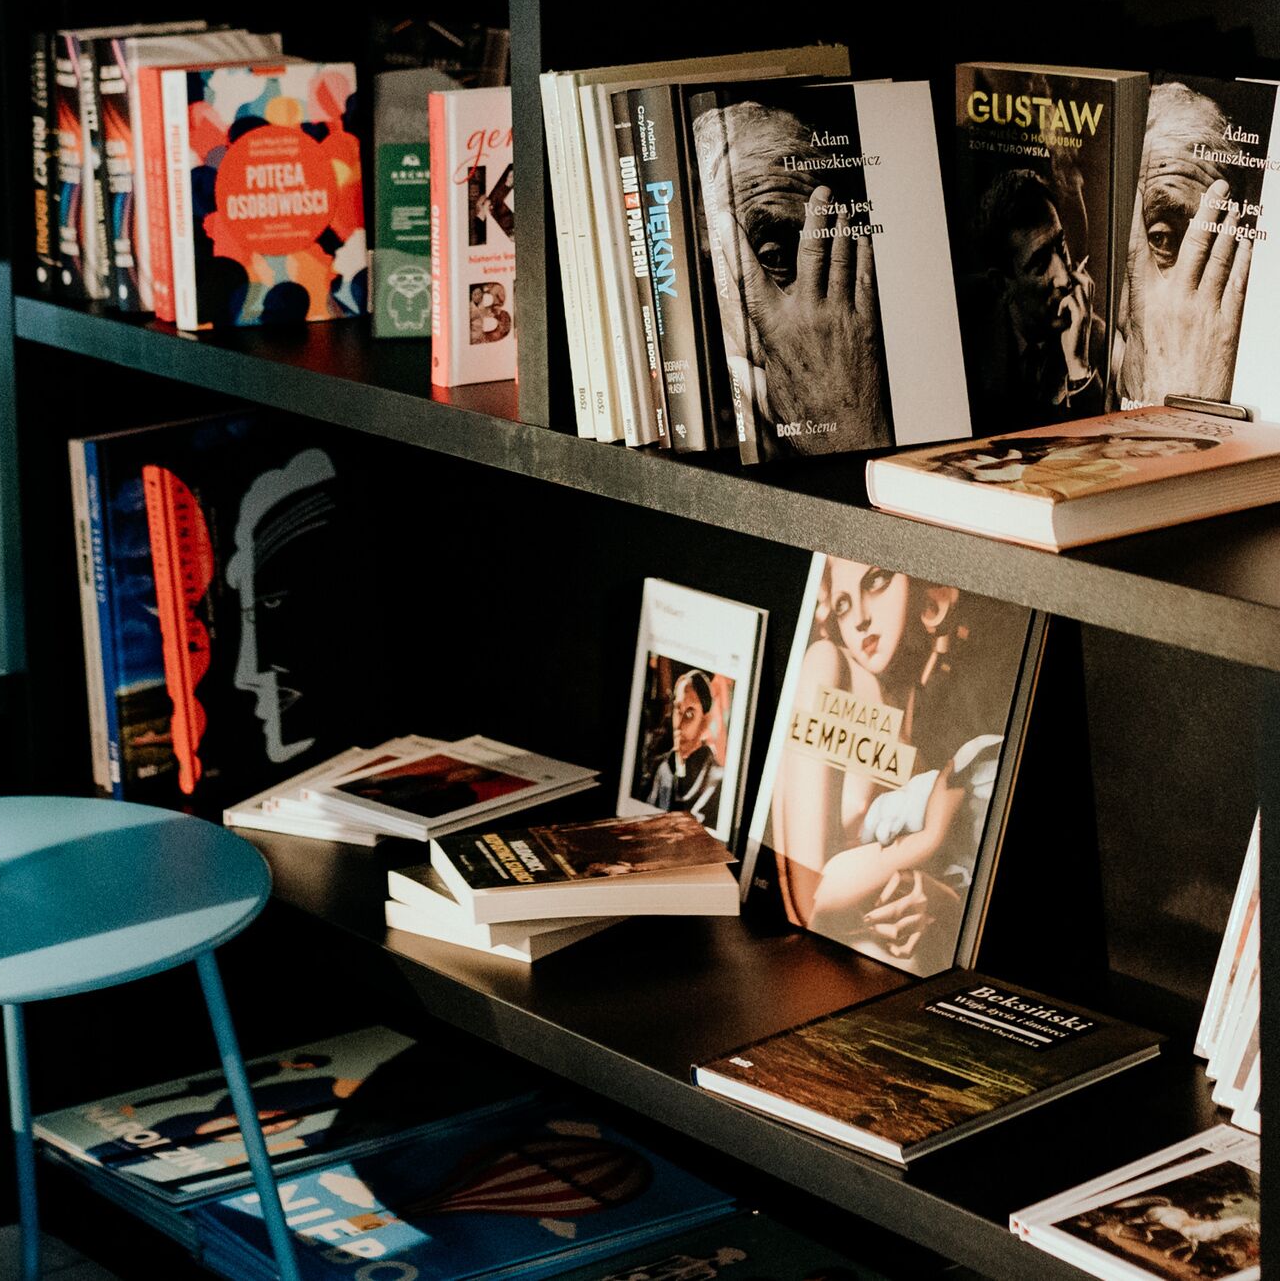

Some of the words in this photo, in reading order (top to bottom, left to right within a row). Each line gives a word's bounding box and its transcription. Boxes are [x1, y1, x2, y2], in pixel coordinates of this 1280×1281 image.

[967, 89, 1104, 137] GUSTAW
[645, 120, 658, 161] Andrzej
[809, 131, 850, 148] Adam
[1222, 124, 1260, 145] Adam
[782, 151, 882, 173] Hanuszkiewicz
[997, 141, 1051, 159] TUROWSKA
[245, 163, 305, 193] POTĘGA
[620, 155, 636, 193] DOM
[226, 189, 329, 220] OSOBOWOŚCI
[803, 200, 849, 218] Reszta
[850, 198, 874, 217] jest
[1239, 198, 1265, 217] jest
[627, 209, 649, 278] PAPIERU
[646, 180, 677, 299] PIĘKNY
[799, 222, 884, 242] monologiem
[1190, 216, 1268, 242] monologiem
[642, 306, 654, 341] ESCAPE
[647, 343, 658, 370] BOOK
[776, 421, 802, 438] BOSZ
[805, 420, 837, 435] Scena
[820, 690, 891, 734] TAMARA
[791, 713, 899, 777] ŁEMPICKA
[968, 986, 1094, 1032] Beksiński
